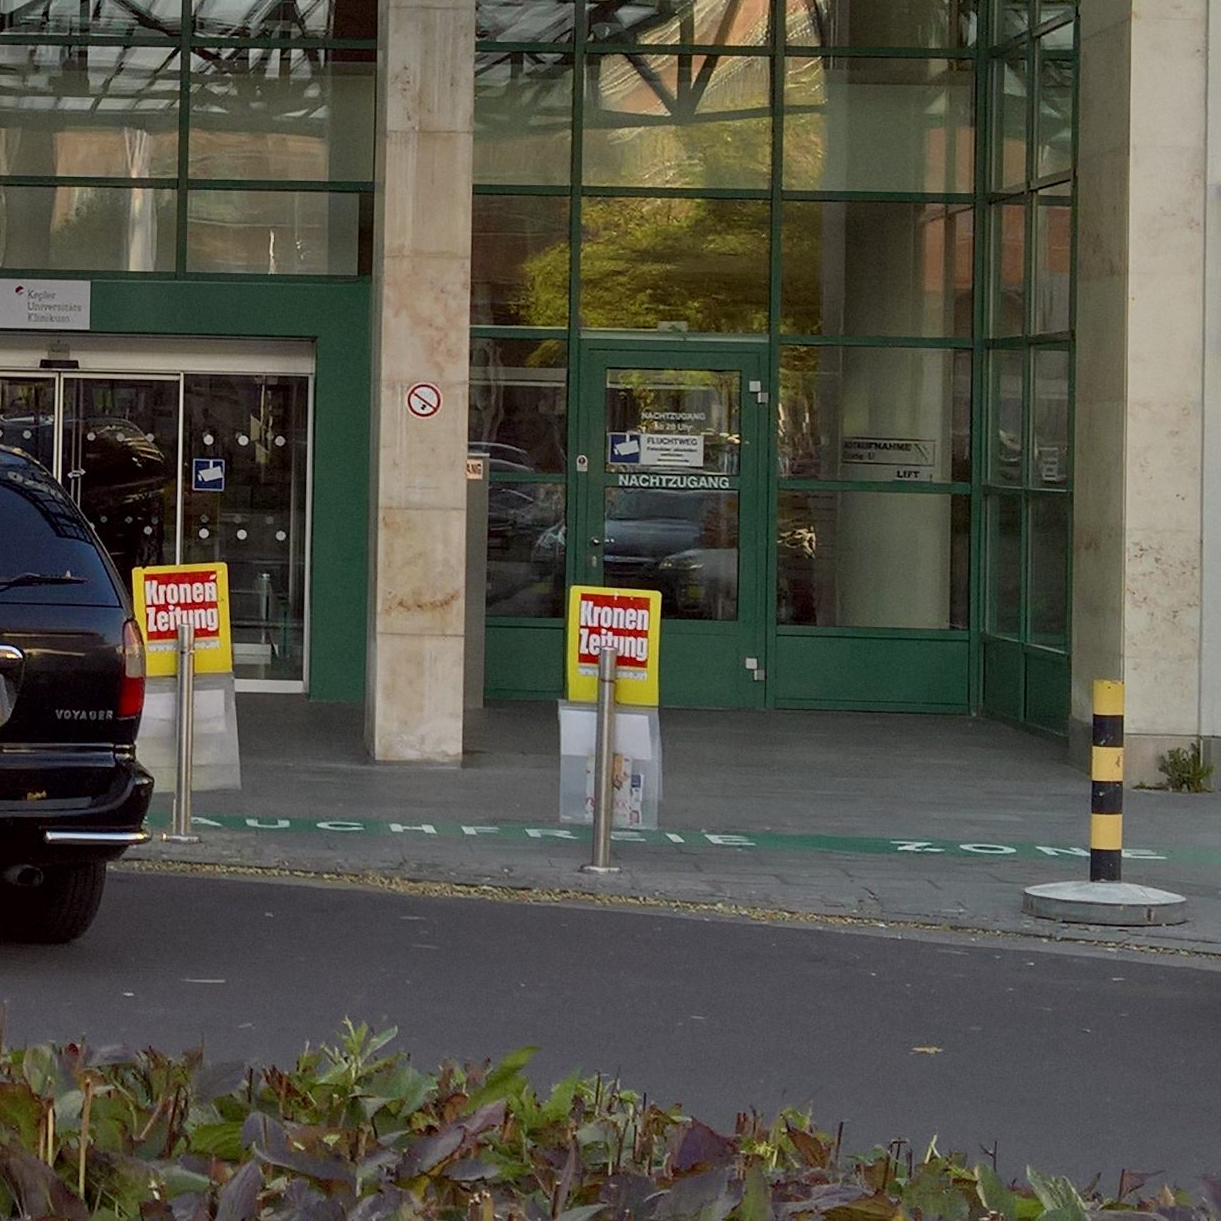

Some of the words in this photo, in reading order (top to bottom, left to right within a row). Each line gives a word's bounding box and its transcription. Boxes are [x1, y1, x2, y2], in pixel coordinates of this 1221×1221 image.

[27, 290, 57, 302] Kepler
[640, 412, 706, 420] NACHTZUGANG
[646, 437, 698, 446] FLUCHTWEG
[896, 470, 921, 479] LIFT
[619, 474, 730, 489] NACHTZUGANG
[145, 579, 218, 606] Kronen
[146, 605, 220, 632] Zeitung
[580, 601, 650, 631] Kronen
[55, 709, 113, 720] VOYAGER
[142, 815, 756, 846] AUCHFREIE
[890, 840, 1168, 860] ZONE
